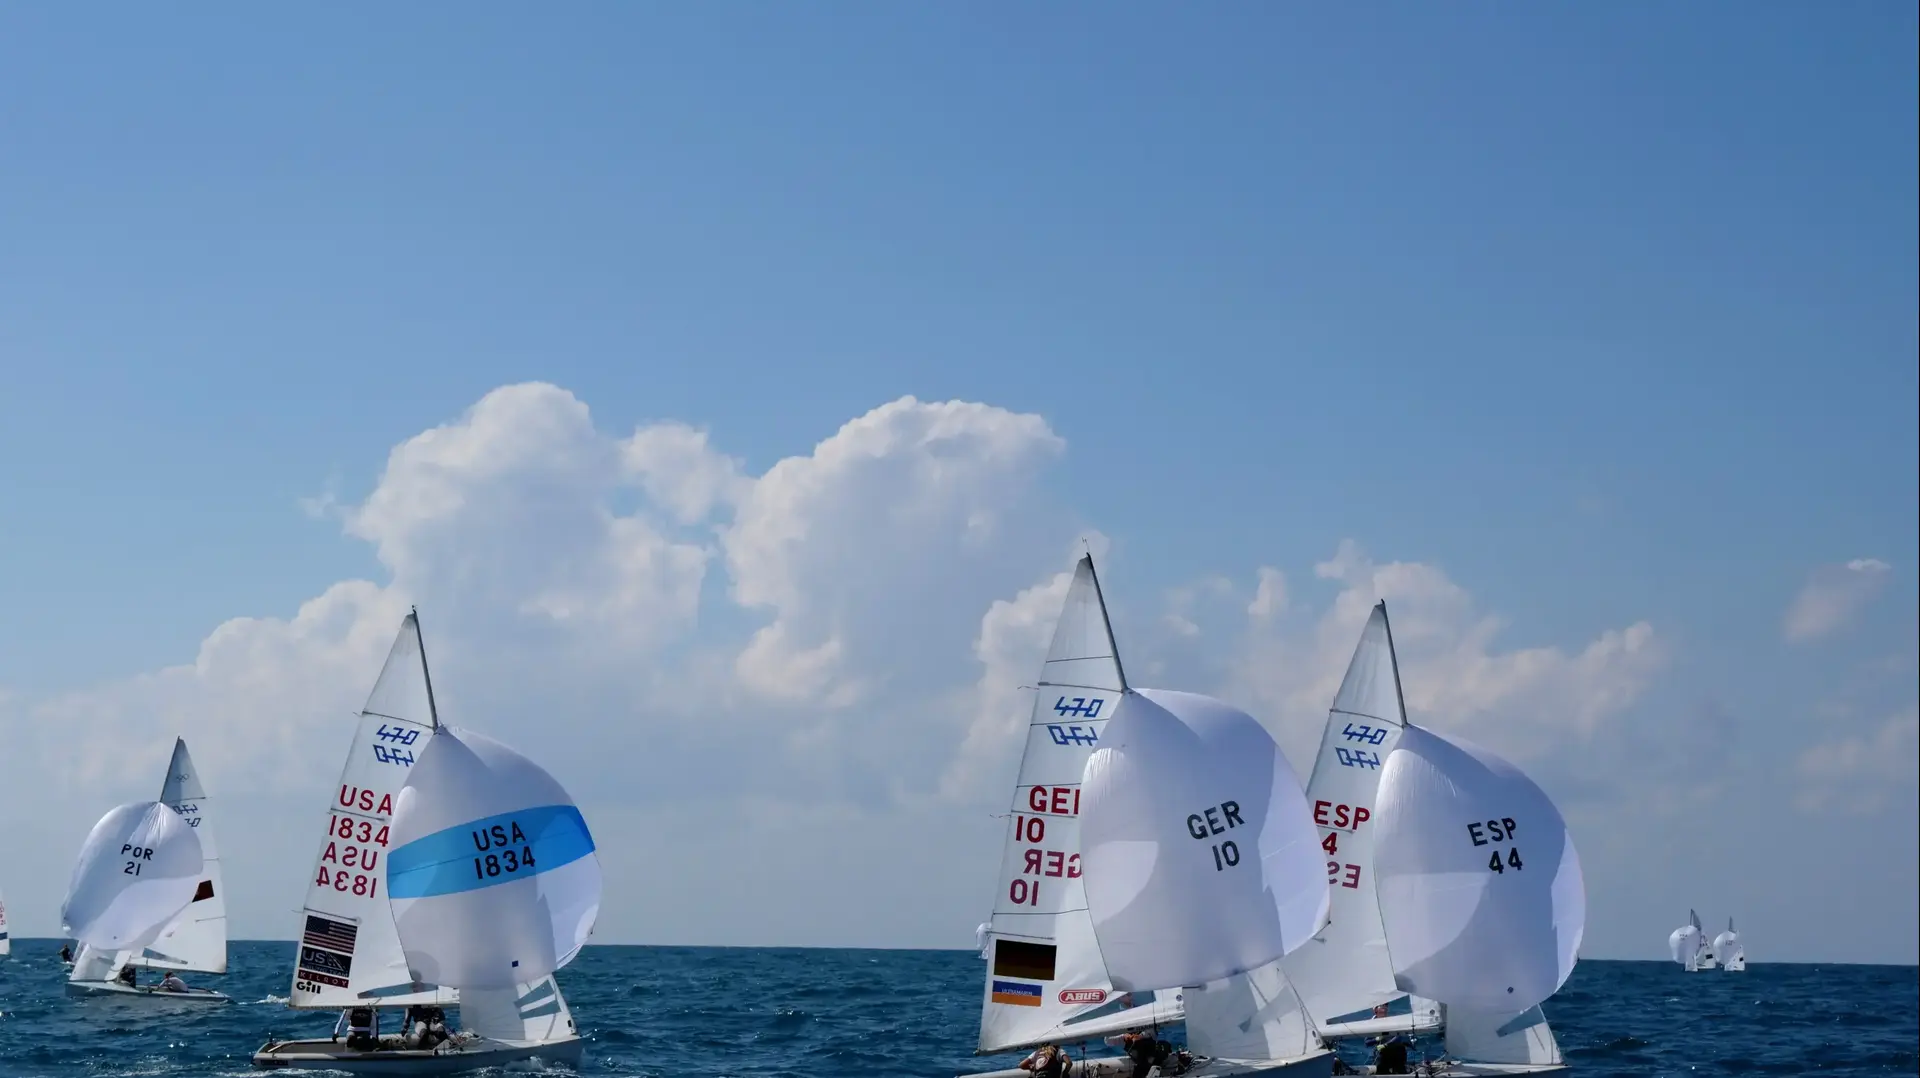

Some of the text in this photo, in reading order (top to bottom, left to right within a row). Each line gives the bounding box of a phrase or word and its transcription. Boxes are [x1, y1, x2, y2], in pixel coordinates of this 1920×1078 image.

[1054, 696, 1104, 718] 470
[376, 724, 420, 746] 470
[1342, 723, 1388, 745] 470
[339, 784, 392, 816] USA
[1187, 800, 1245, 840] GER
[1313, 800, 1370, 830] ESP
[328, 815, 390, 847] 1834
[472, 821, 526, 852] USA
[1015, 816, 1045, 843] 10
[1467, 817, 1516, 847] ESP
[121, 844, 153, 860] POR
[474, 845, 536, 879] 1834
[1212, 840, 1240, 871] 10
[1489, 847, 1523, 874] 44
[124, 861, 141, 876] 21
[296, 981, 321, 994] Gill
[300, 971, 347, 986] KILROY
[1064, 992, 1100, 1001] ABUS
